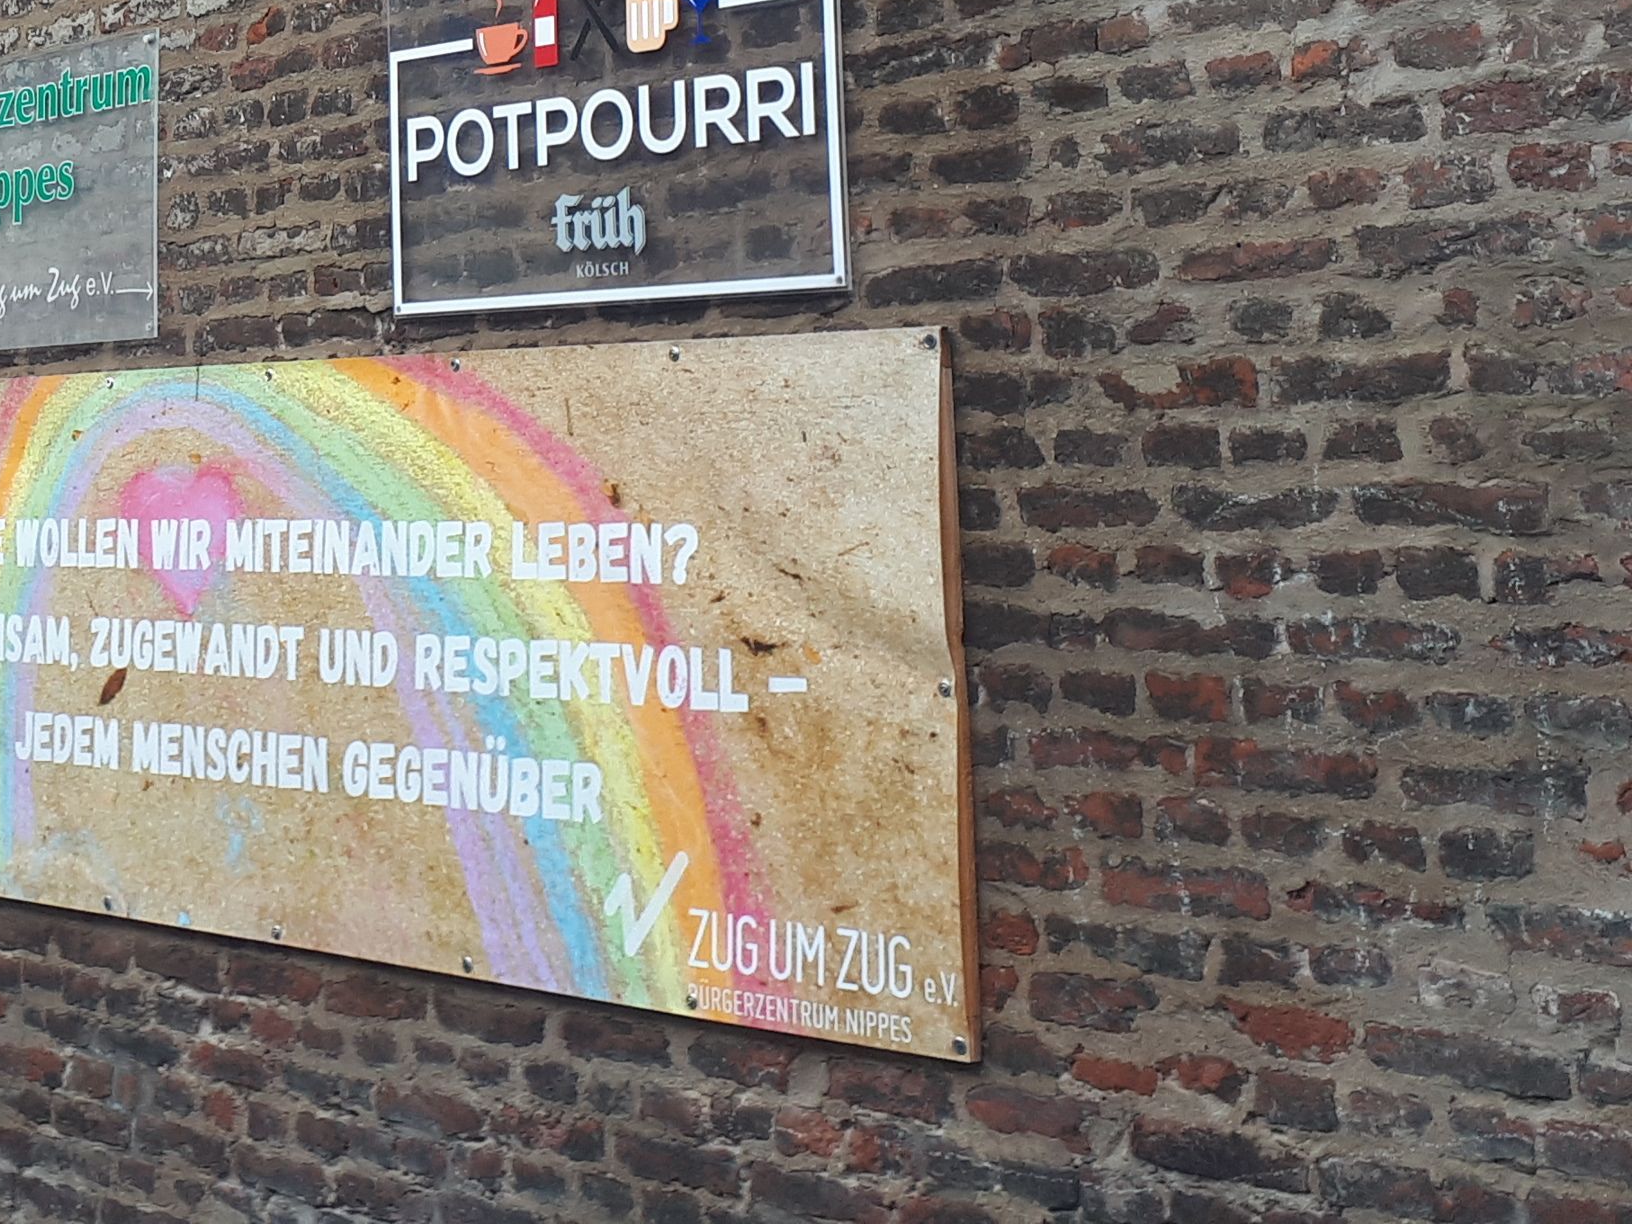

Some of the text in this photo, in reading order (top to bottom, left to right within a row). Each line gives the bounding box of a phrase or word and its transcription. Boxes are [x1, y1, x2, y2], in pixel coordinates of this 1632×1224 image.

[405, 61, 817, 183] POTPOURRI
[47, 267, 81, 306] Zug
[86, 271, 115, 297] e.V.
[575, 260, 630, 279] KÖLSCH
[15, 519, 138, 569] WOLLEN
[151, 519, 213, 571] WIR
[225, 519, 491, 577] MITEINANDER
[511, 521, 699, 585] LEBEN?
[90, 616, 304, 681] ZUGEWANDT
[319, 628, 399, 688] UND
[414, 633, 750, 713] RESPEKTVOLL
[14, 710, 604, 824] JEDEM MENSCHEN GEGENÜBER
[687, 908, 959, 1007] ZUG UM ZUG e.V.
[845, 1010, 913, 1043] NIPPES
